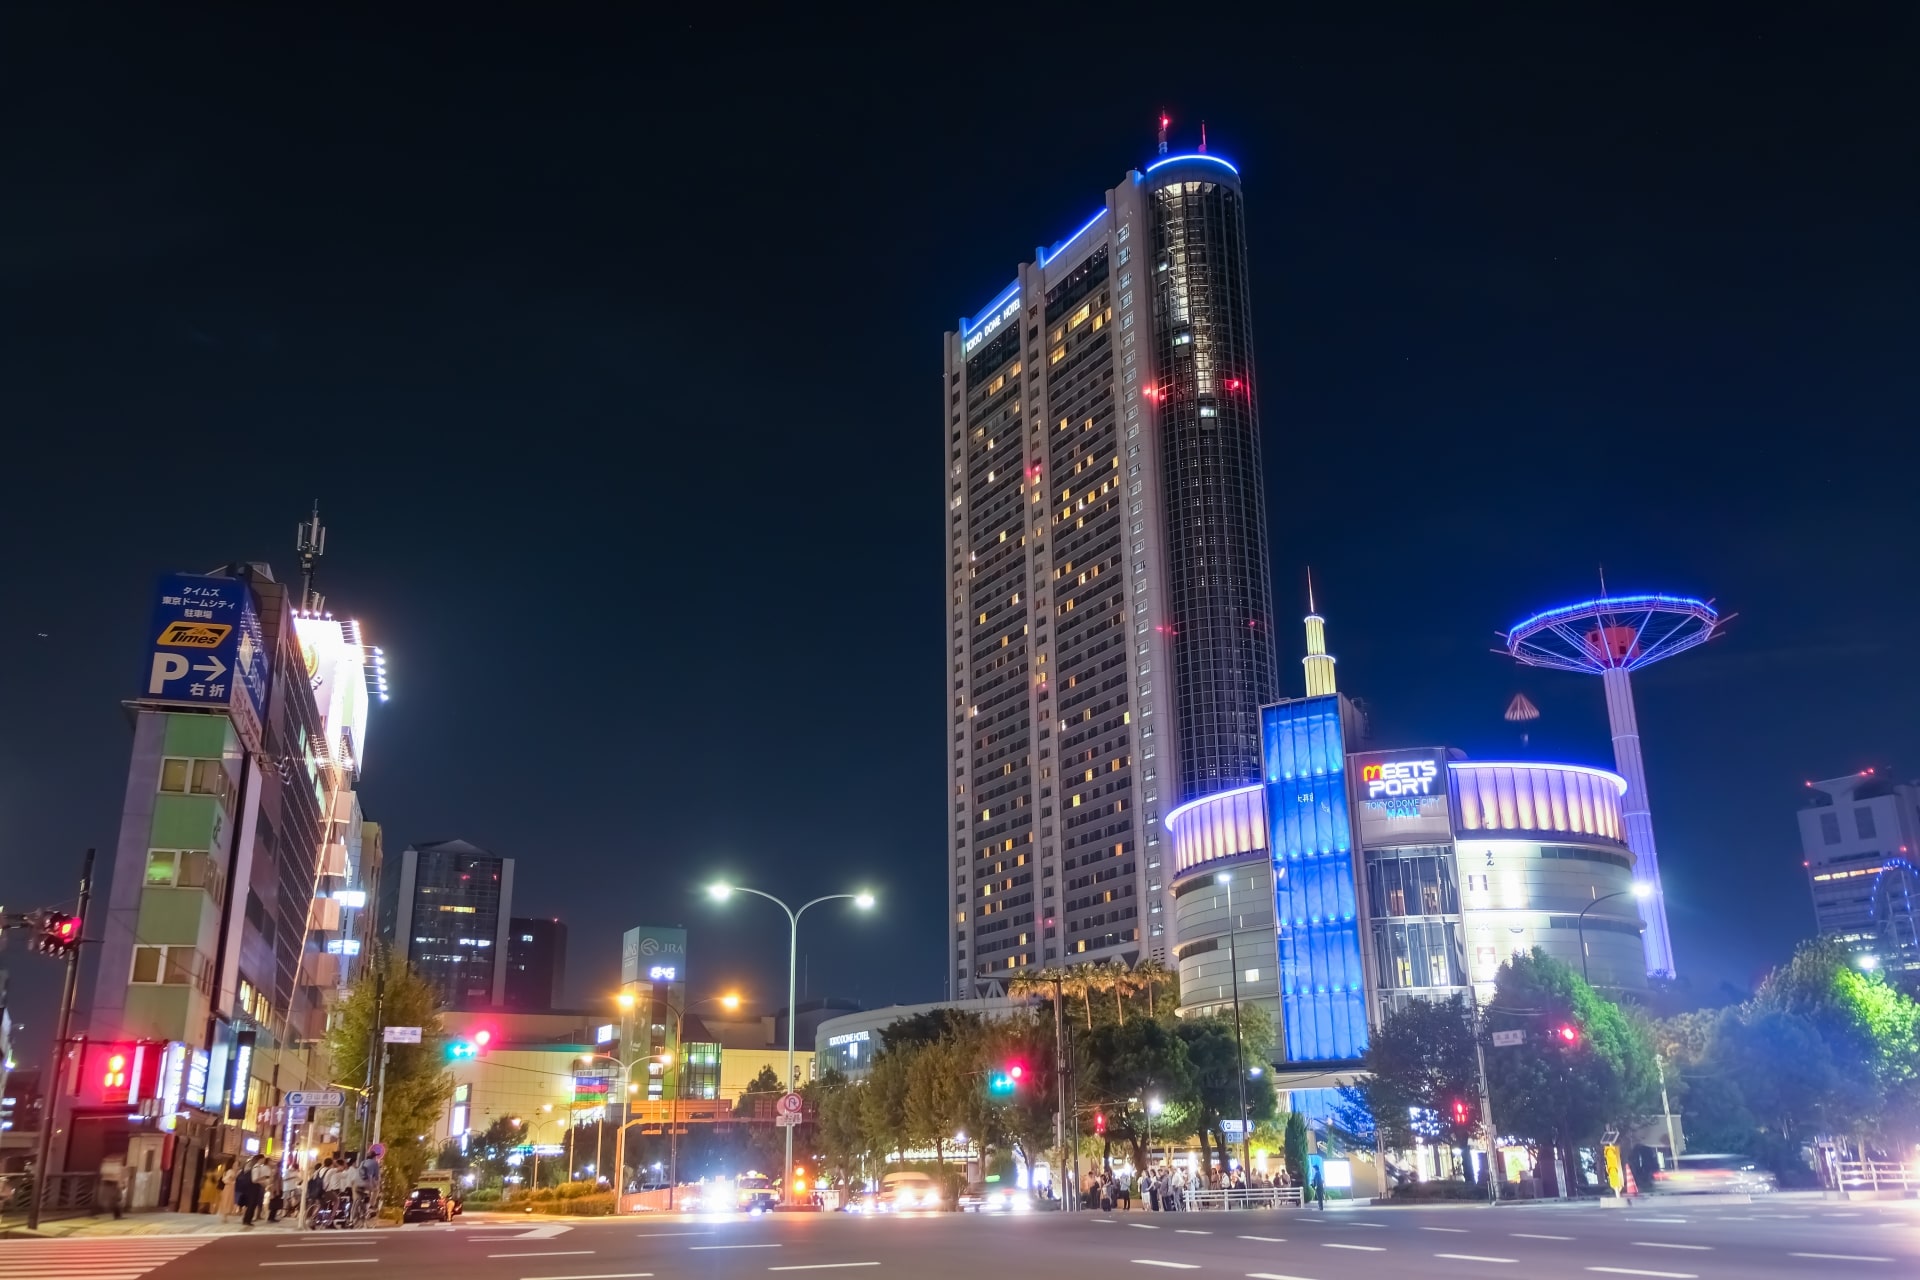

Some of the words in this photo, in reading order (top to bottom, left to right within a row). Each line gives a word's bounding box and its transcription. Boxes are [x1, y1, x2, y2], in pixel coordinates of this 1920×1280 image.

[984, 315, 1001, 336] DOME
[1003, 298, 1020, 320] HOTEL
[183, 586, 220, 597] タイムズ
[162, 596, 235, 610] 東京ドームシティ
[184, 608, 213, 619] 駐車場
[169, 627, 219, 645] Times
[148, 652, 190, 694] P
[189, 682, 225, 698] 右折
[1368, 776, 1433, 798] PORT
[1365, 800, 1394, 811] TOKYO
[1396, 798, 1420, 808] DOME
[661, 943, 684, 954] JRA
[854, 1031, 870, 1041] HOTEL
